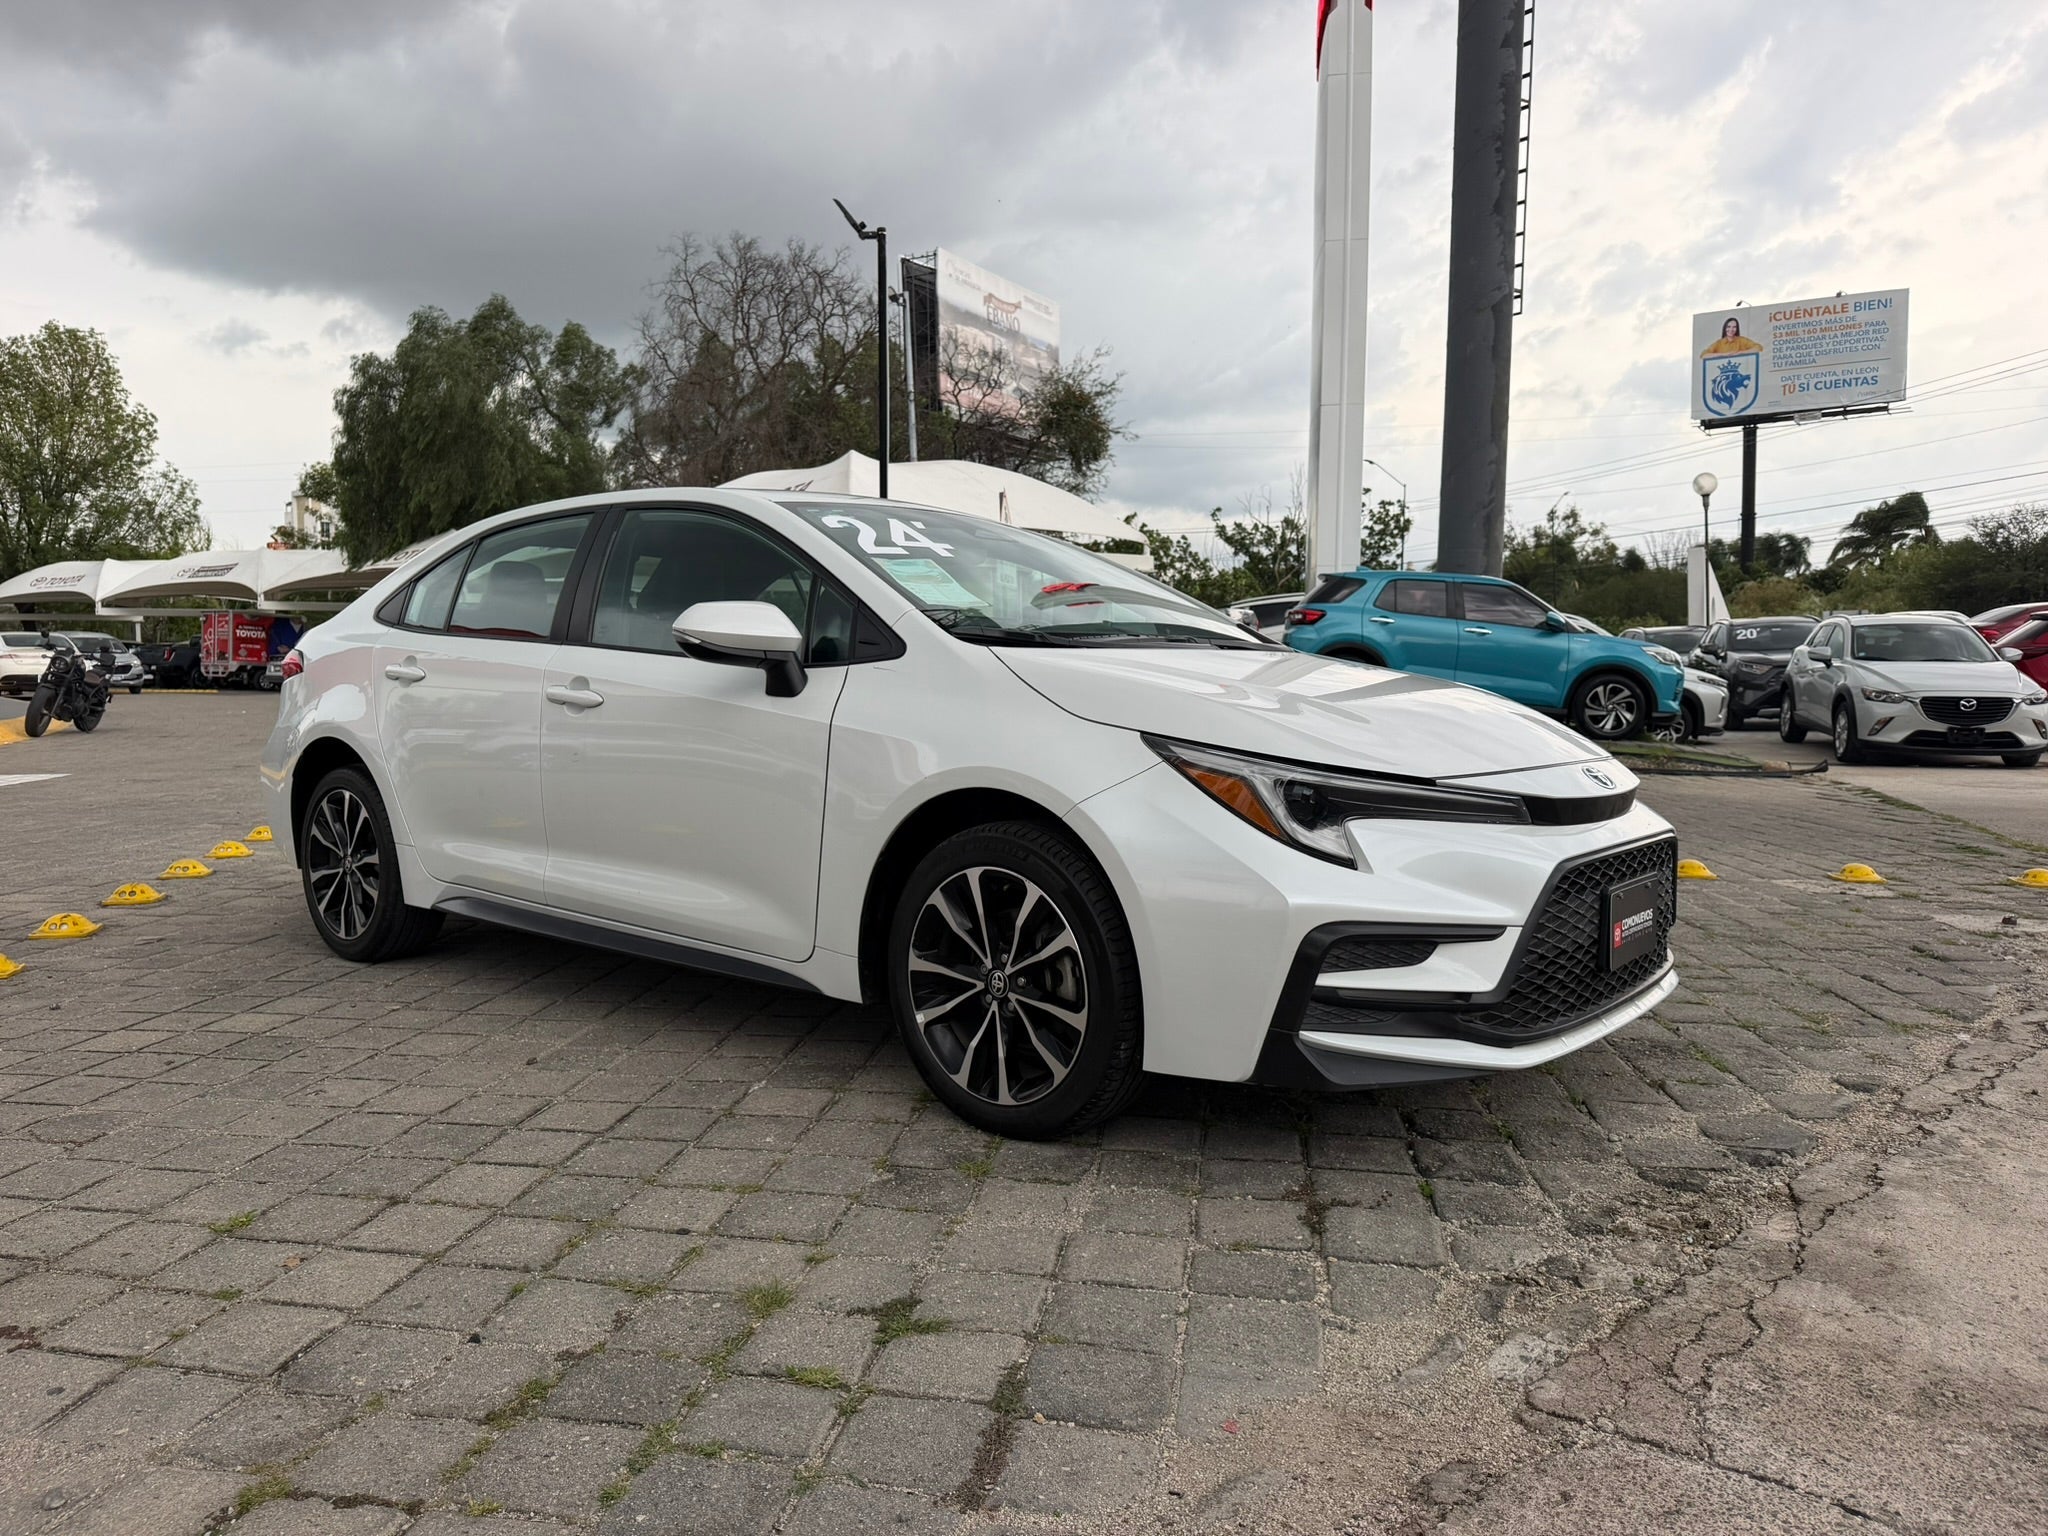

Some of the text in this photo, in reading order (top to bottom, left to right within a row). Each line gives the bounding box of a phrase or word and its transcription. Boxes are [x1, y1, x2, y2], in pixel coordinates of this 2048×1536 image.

[1769, 298, 1893, 322] ¡CUÉNTALE BIEN!
[1772, 315, 1857, 331] INVERTIMOS MÁS DE
[1785, 330, 1800, 338] MIL
[1802, 327, 1818, 336] 160
[1820, 322, 1862, 333] MILLONES
[1864, 320, 1887, 328] PARA
[1772, 327, 1889, 346] CONSOLIDAR LA MEJOR RED
[1785, 343, 1823, 352] PARQUES
[1795, 350, 1814, 359] QUE
[1815, 345, 1859, 356] DISFRUTES
[1860, 343, 1880, 351] CON
[1784, 358, 1817, 367] FAMILIA
[1780, 374, 1801, 383] DATE
[1841, 368, 1854, 376] EN
[1781, 375, 1879, 396] TÚ SÍ CUENTAS
[235, 629, 266, 639] TOYOTA
